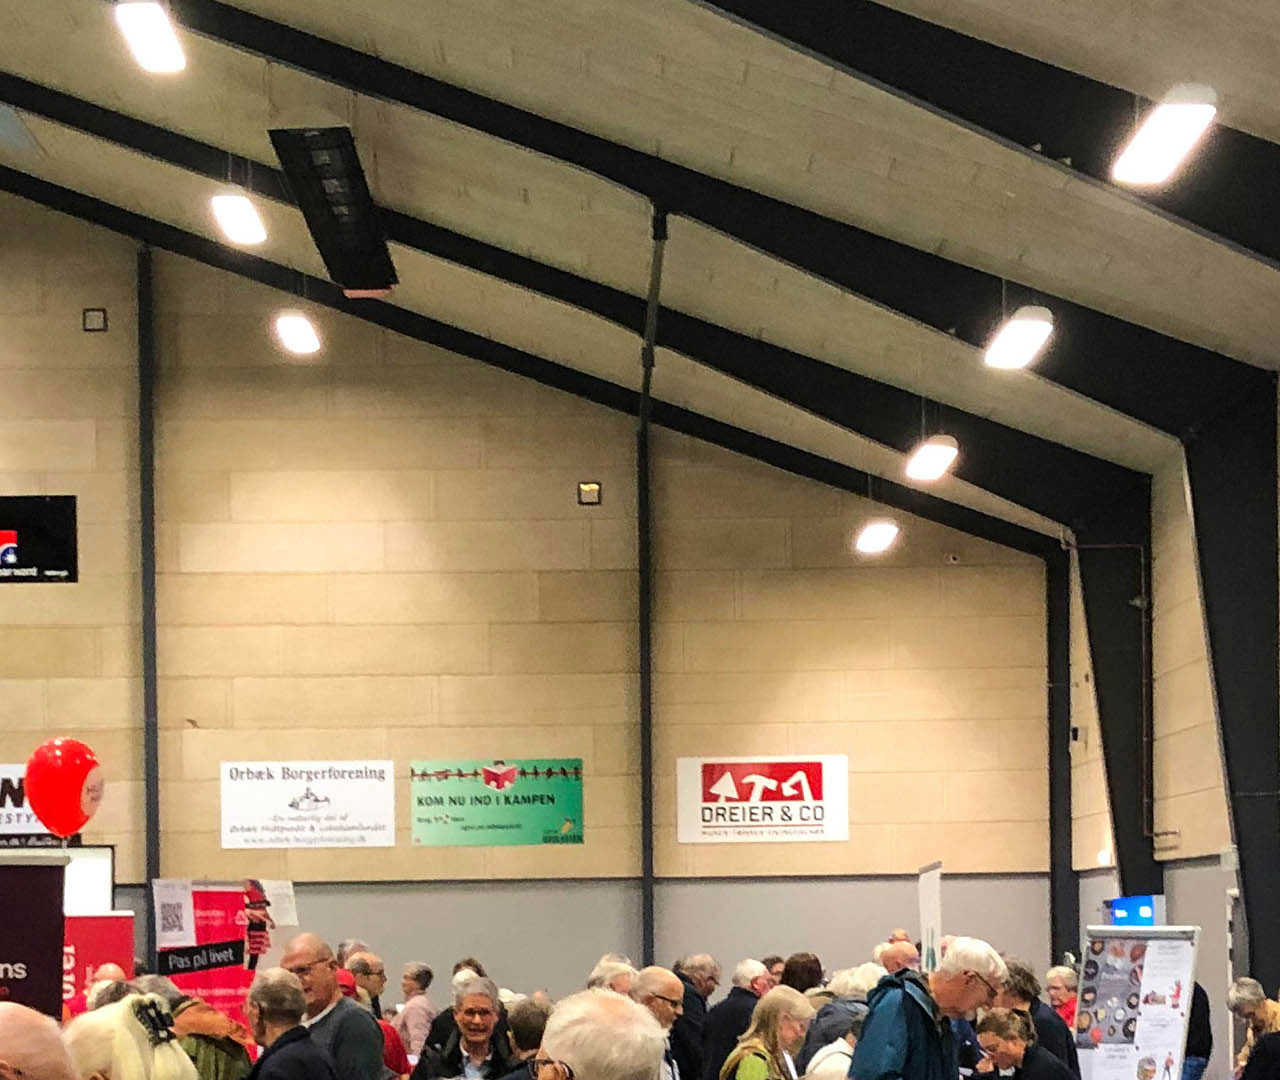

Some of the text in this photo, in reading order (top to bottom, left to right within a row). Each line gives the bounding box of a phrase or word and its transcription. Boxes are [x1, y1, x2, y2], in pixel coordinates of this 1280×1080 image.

[281, 766, 386, 782] Borgerforening
[417, 796, 444, 807] KOM
[448, 796, 466, 807] NU
[471, 795, 492, 806] IND
[504, 794, 556, 806] KAMPEN
[701, 805, 825, 822] DREIER & CO
